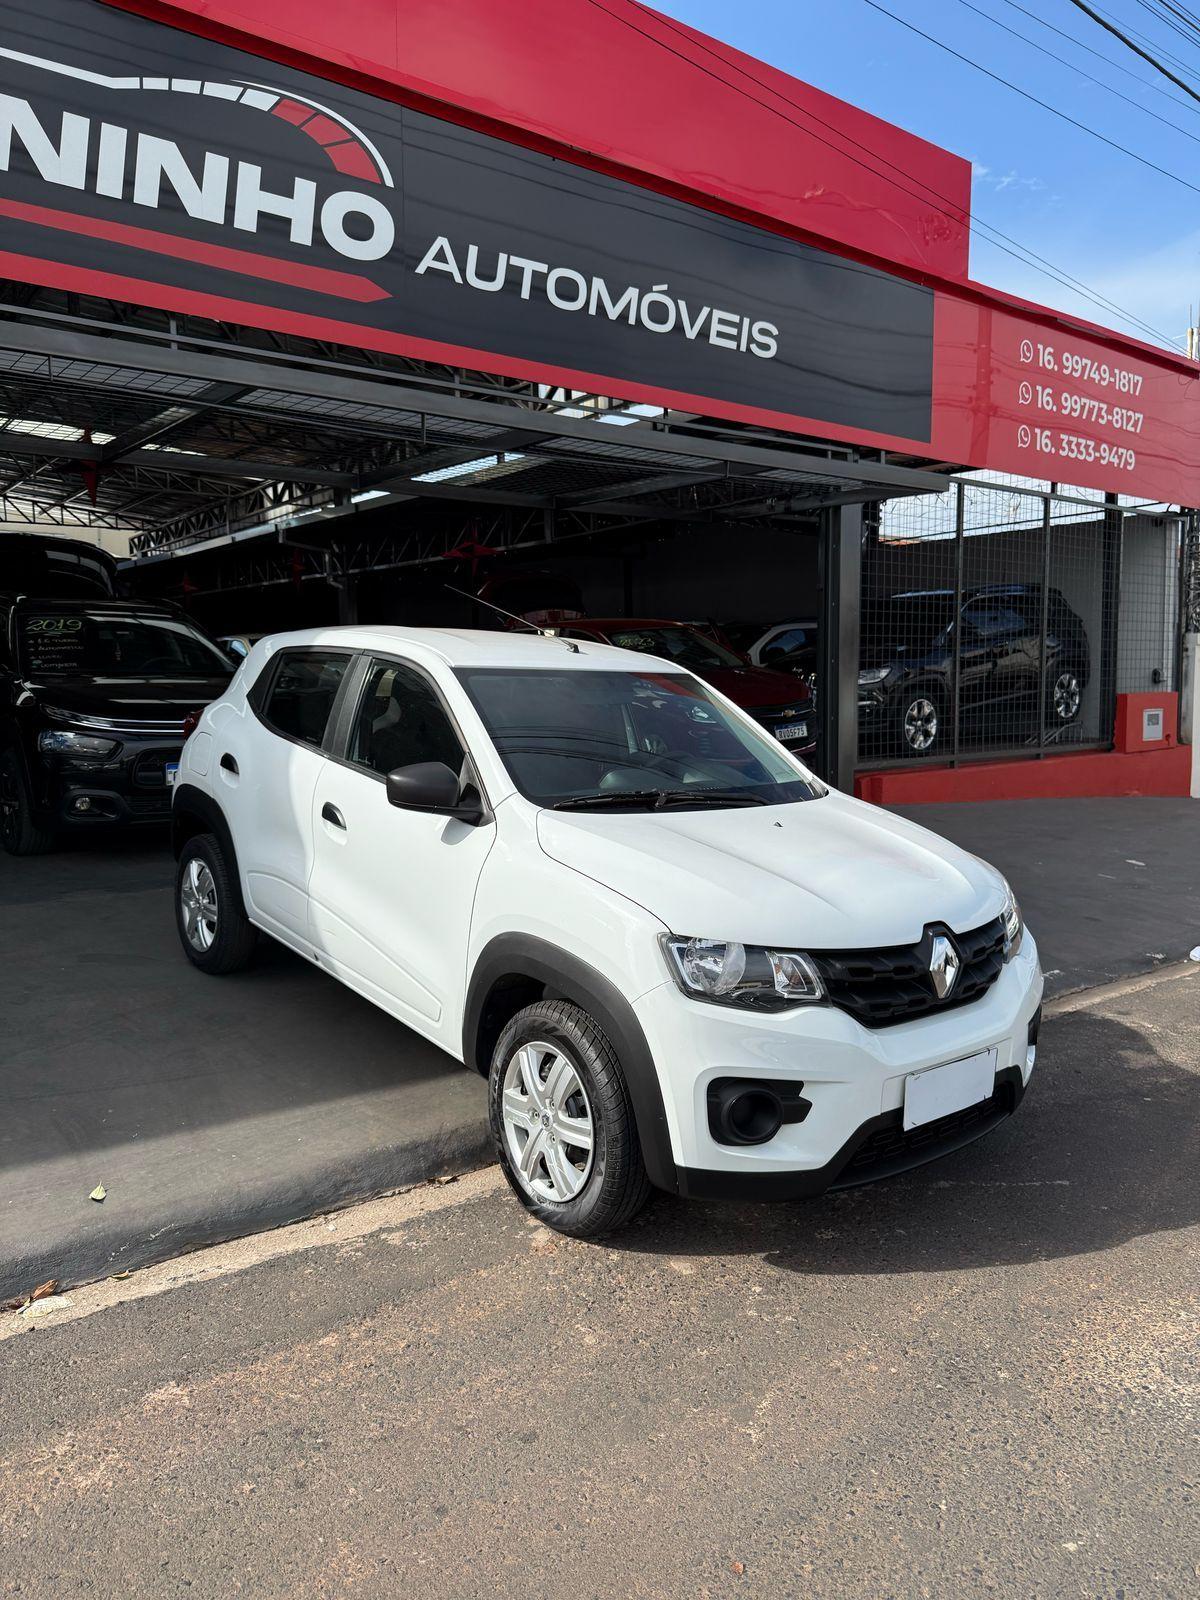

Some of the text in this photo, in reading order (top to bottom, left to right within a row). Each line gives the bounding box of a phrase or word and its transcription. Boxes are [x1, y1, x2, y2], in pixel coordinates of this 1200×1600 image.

[0, 93, 780, 360] NINHO AUTOMÓVEIS
[1037, 343, 1143, 396] 16. 99749-1817
[1035, 385, 1144, 433] 16. 99773-8127
[1034, 427, 1136, 471] 16. 3333-9479
[25, 618, 82, 631] 2019
